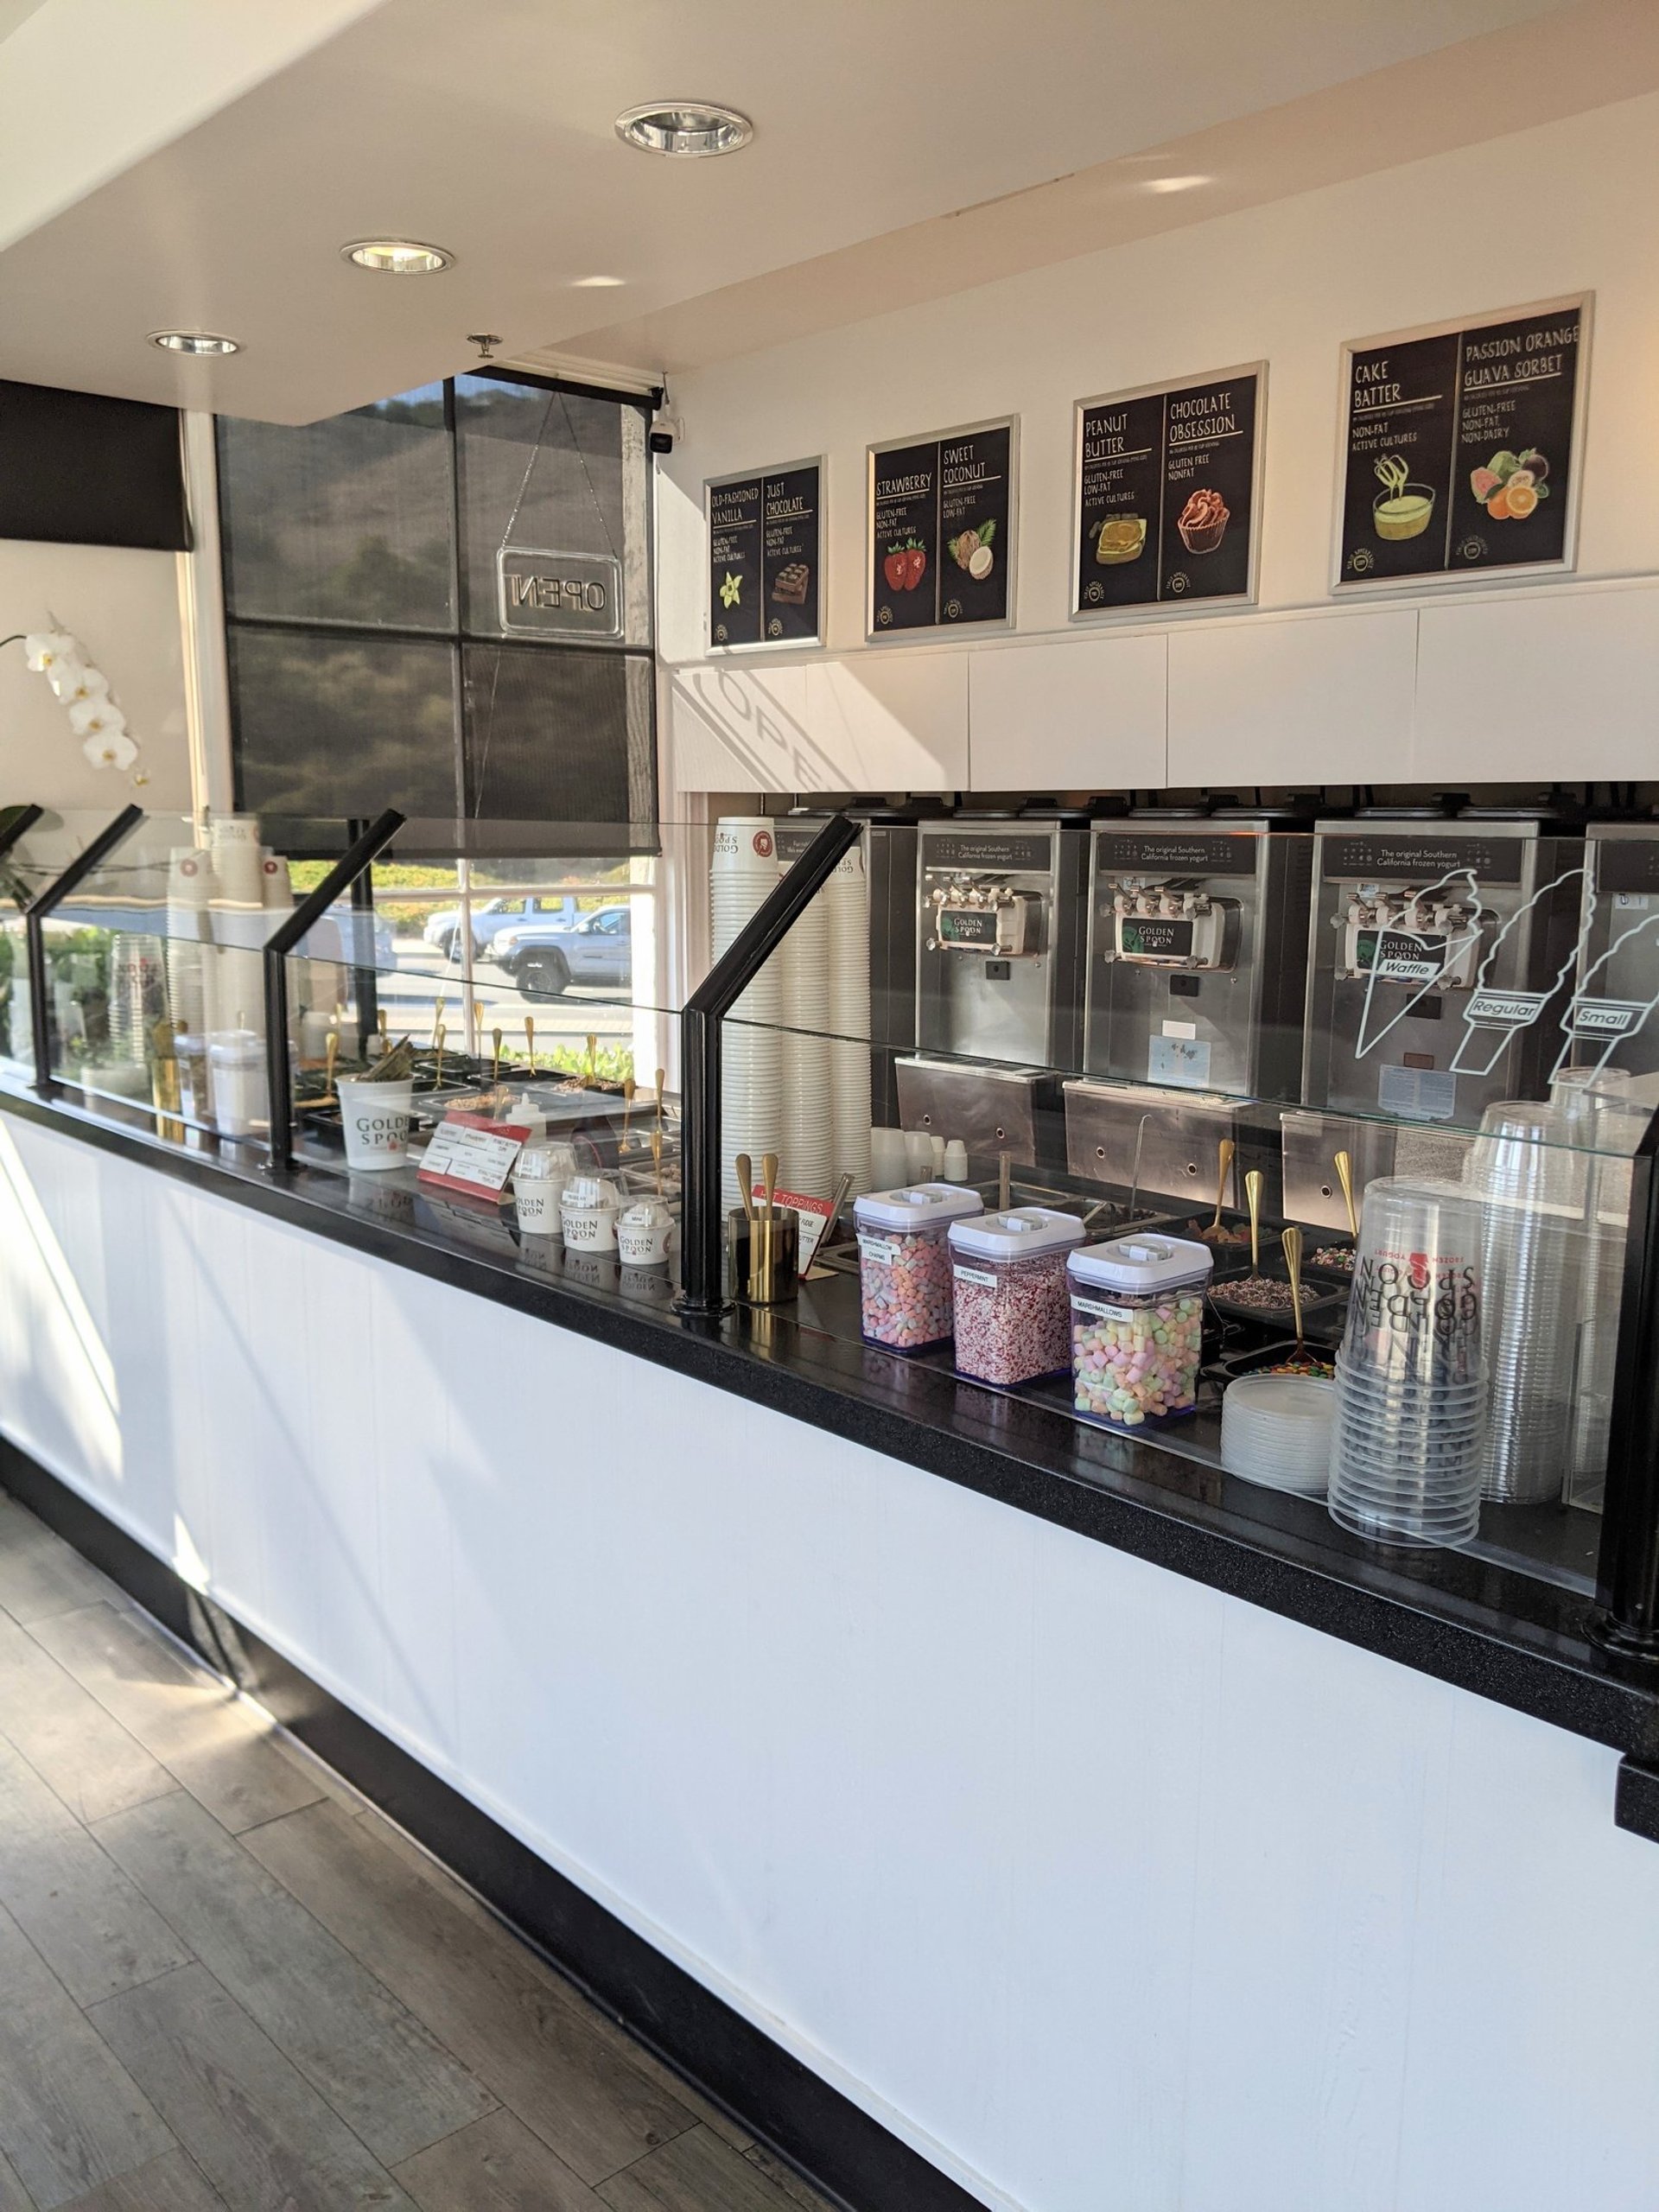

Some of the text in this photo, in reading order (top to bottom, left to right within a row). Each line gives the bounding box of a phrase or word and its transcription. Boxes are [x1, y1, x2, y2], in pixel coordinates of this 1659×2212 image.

[1465, 326, 1580, 362] PASSION ORANGE
[1355, 360, 1389, 384] CAKE
[1465, 354, 1562, 387] GUAVA SORBET
[1354, 383, 1402, 408] BATTER
[1170, 392, 1231, 420] CHOCOLATE
[1463, 399, 1516, 418] GLUTEN-FREE
[1085, 413, 1128, 437] PEANUT
[1170, 415, 1235, 442] OBSESSION
[1352, 422, 1389, 438] NON-FAT
[1352, 432, 1417, 451] ACTIVE CULTURES
[1461, 427, 1510, 443] NON-DAIRY
[944, 444, 974, 465] SWEET
[1085, 436, 1124, 458] BUTTER
[1168, 454, 1209, 469] GLUTEN FREE
[944, 462, 985, 484] COCONUT
[1084, 468, 1123, 484] GLUTEN-FREE
[1168, 467, 1194, 480] NONFAT
[766, 481, 785, 499] JUST
[876, 472, 932, 496] STRAWBERRY
[1084, 481, 1110, 495] LOW-FAT
[711, 487, 759, 507] OLD-FASHIONED
[944, 495, 976, 508] GLUTEN-FREE
[1085, 491, 1135, 506] ACTIVE CULTURES
[766, 497, 804, 515] CHOCOLATE
[876, 506, 906, 519] GLUTEN-FREE
[712, 508, 742, 524] VANILLA
[876, 518, 897, 529] NON-FAT
[877, 530, 893, 538] ACTIVE
[1155, 846, 1177, 855] original
[1395, 849, 1422, 859] original
[1423, 849, 1458, 858] Southern
[1189, 855, 1209, 863] yogurt
[1376, 858, 1461, 869] California frozen yogurt
[954, 918, 982, 927] GOLDEN
[1138, 925, 1174, 937] GOLDEN
[1140, 936, 1173, 944] SPOON
[1380, 940, 1422, 952] GOLDEN
[1380, 950, 1420, 960] SPOON
[1384, 962, 1429, 975] Waffle
[1472, 1001, 1536, 1016] Regular
[1579, 1011, 1630, 1026] Small
[357, 1116, 410, 1132] GOLD
[517, 1198, 544, 1207] OLDEN
[760, 1191, 823, 1214] HT TOPPINGS
[800, 1218, 815, 1228] FUDGE
[620, 1236, 653, 1247] GOLDEN
[1375, 1249, 1406, 1261] YOGURT
[960, 1270, 989, 1282] PEPPERMINT
[1360, 1256, 1474, 1291] SPOON
[1077, 1300, 1123, 1318] MARSHMALLOWS
